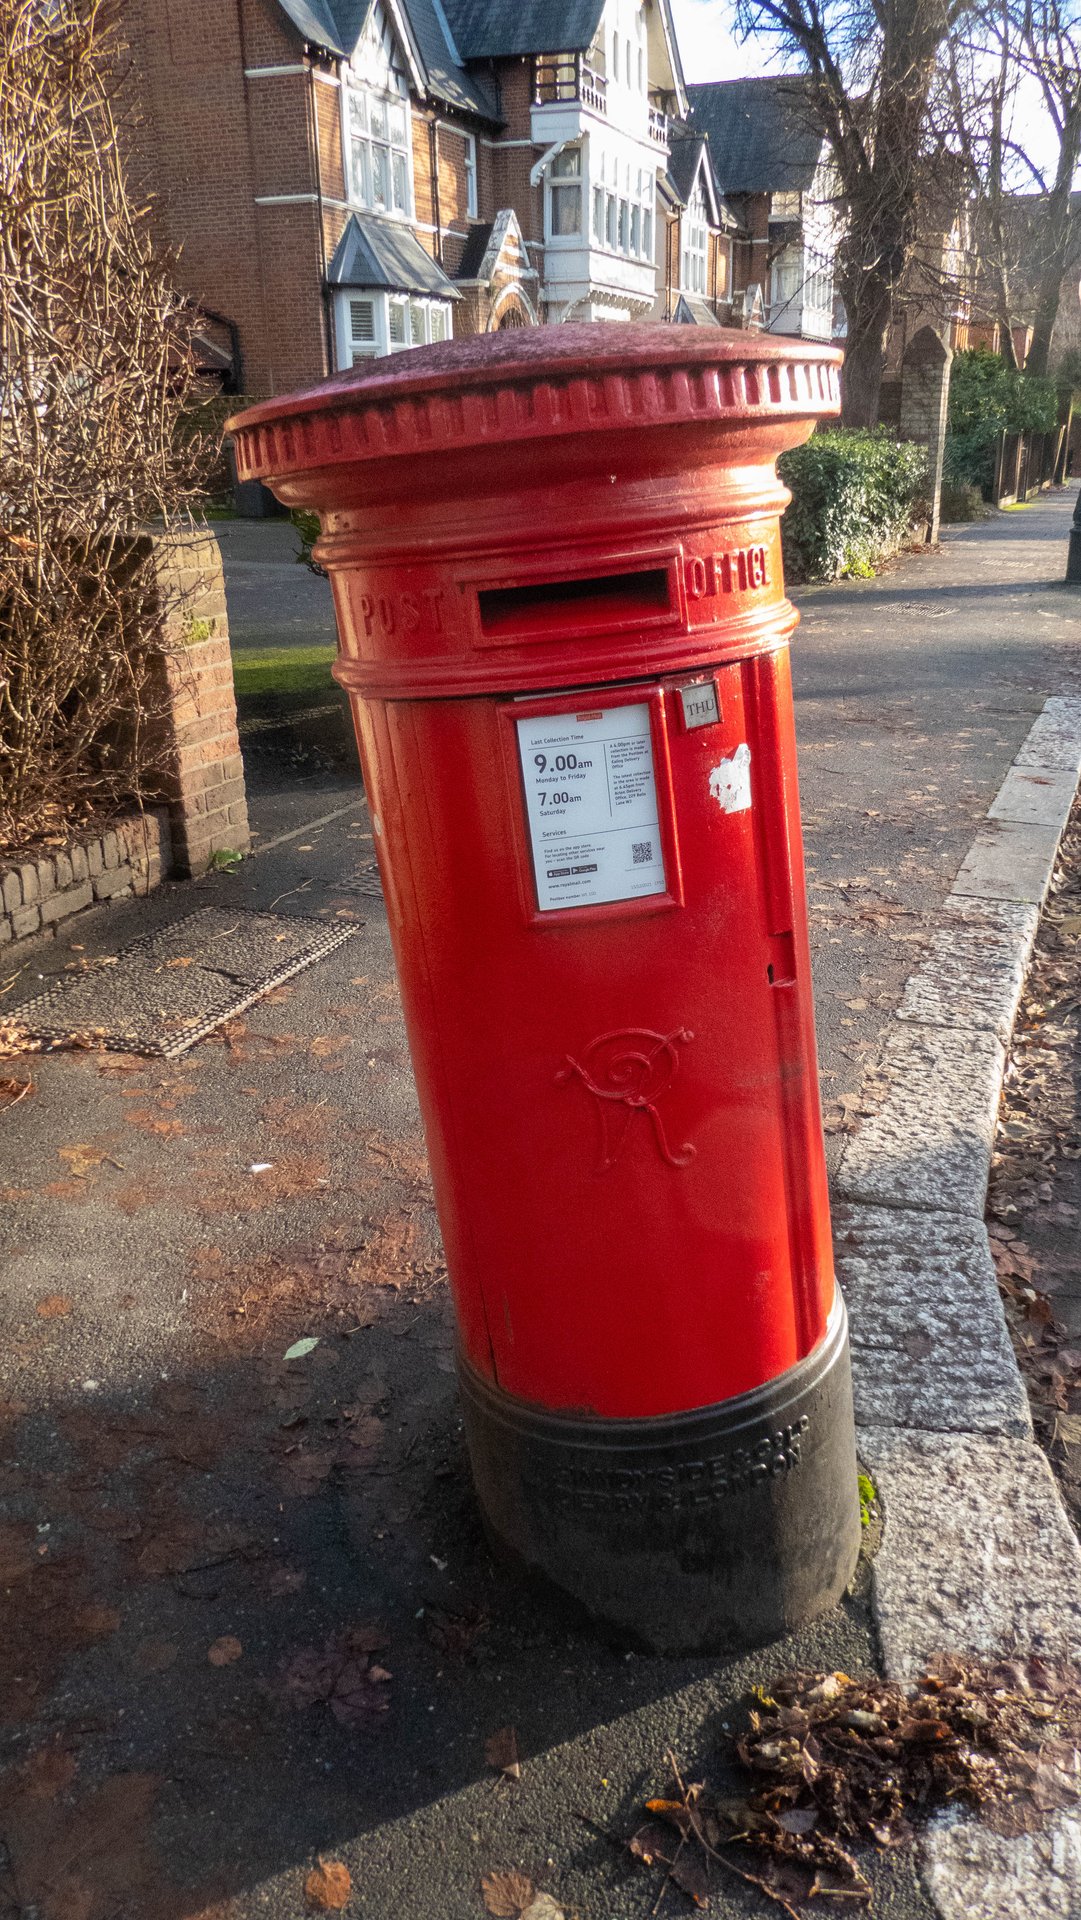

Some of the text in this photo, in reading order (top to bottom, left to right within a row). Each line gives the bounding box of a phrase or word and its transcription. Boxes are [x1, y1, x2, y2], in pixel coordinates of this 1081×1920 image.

[689, 545, 771, 600] OFFICE
[360, 588, 444, 637] POST
[686, 699, 715, 716] THU
[544, 736, 569, 744] Collection
[534, 754, 593, 774] 9.00am
[538, 791, 582, 806] 7.00am
[540, 808, 566, 817] Saturday
[542, 829, 567, 838] Services
[548, 880, 591, 888] www.royalmail.com
